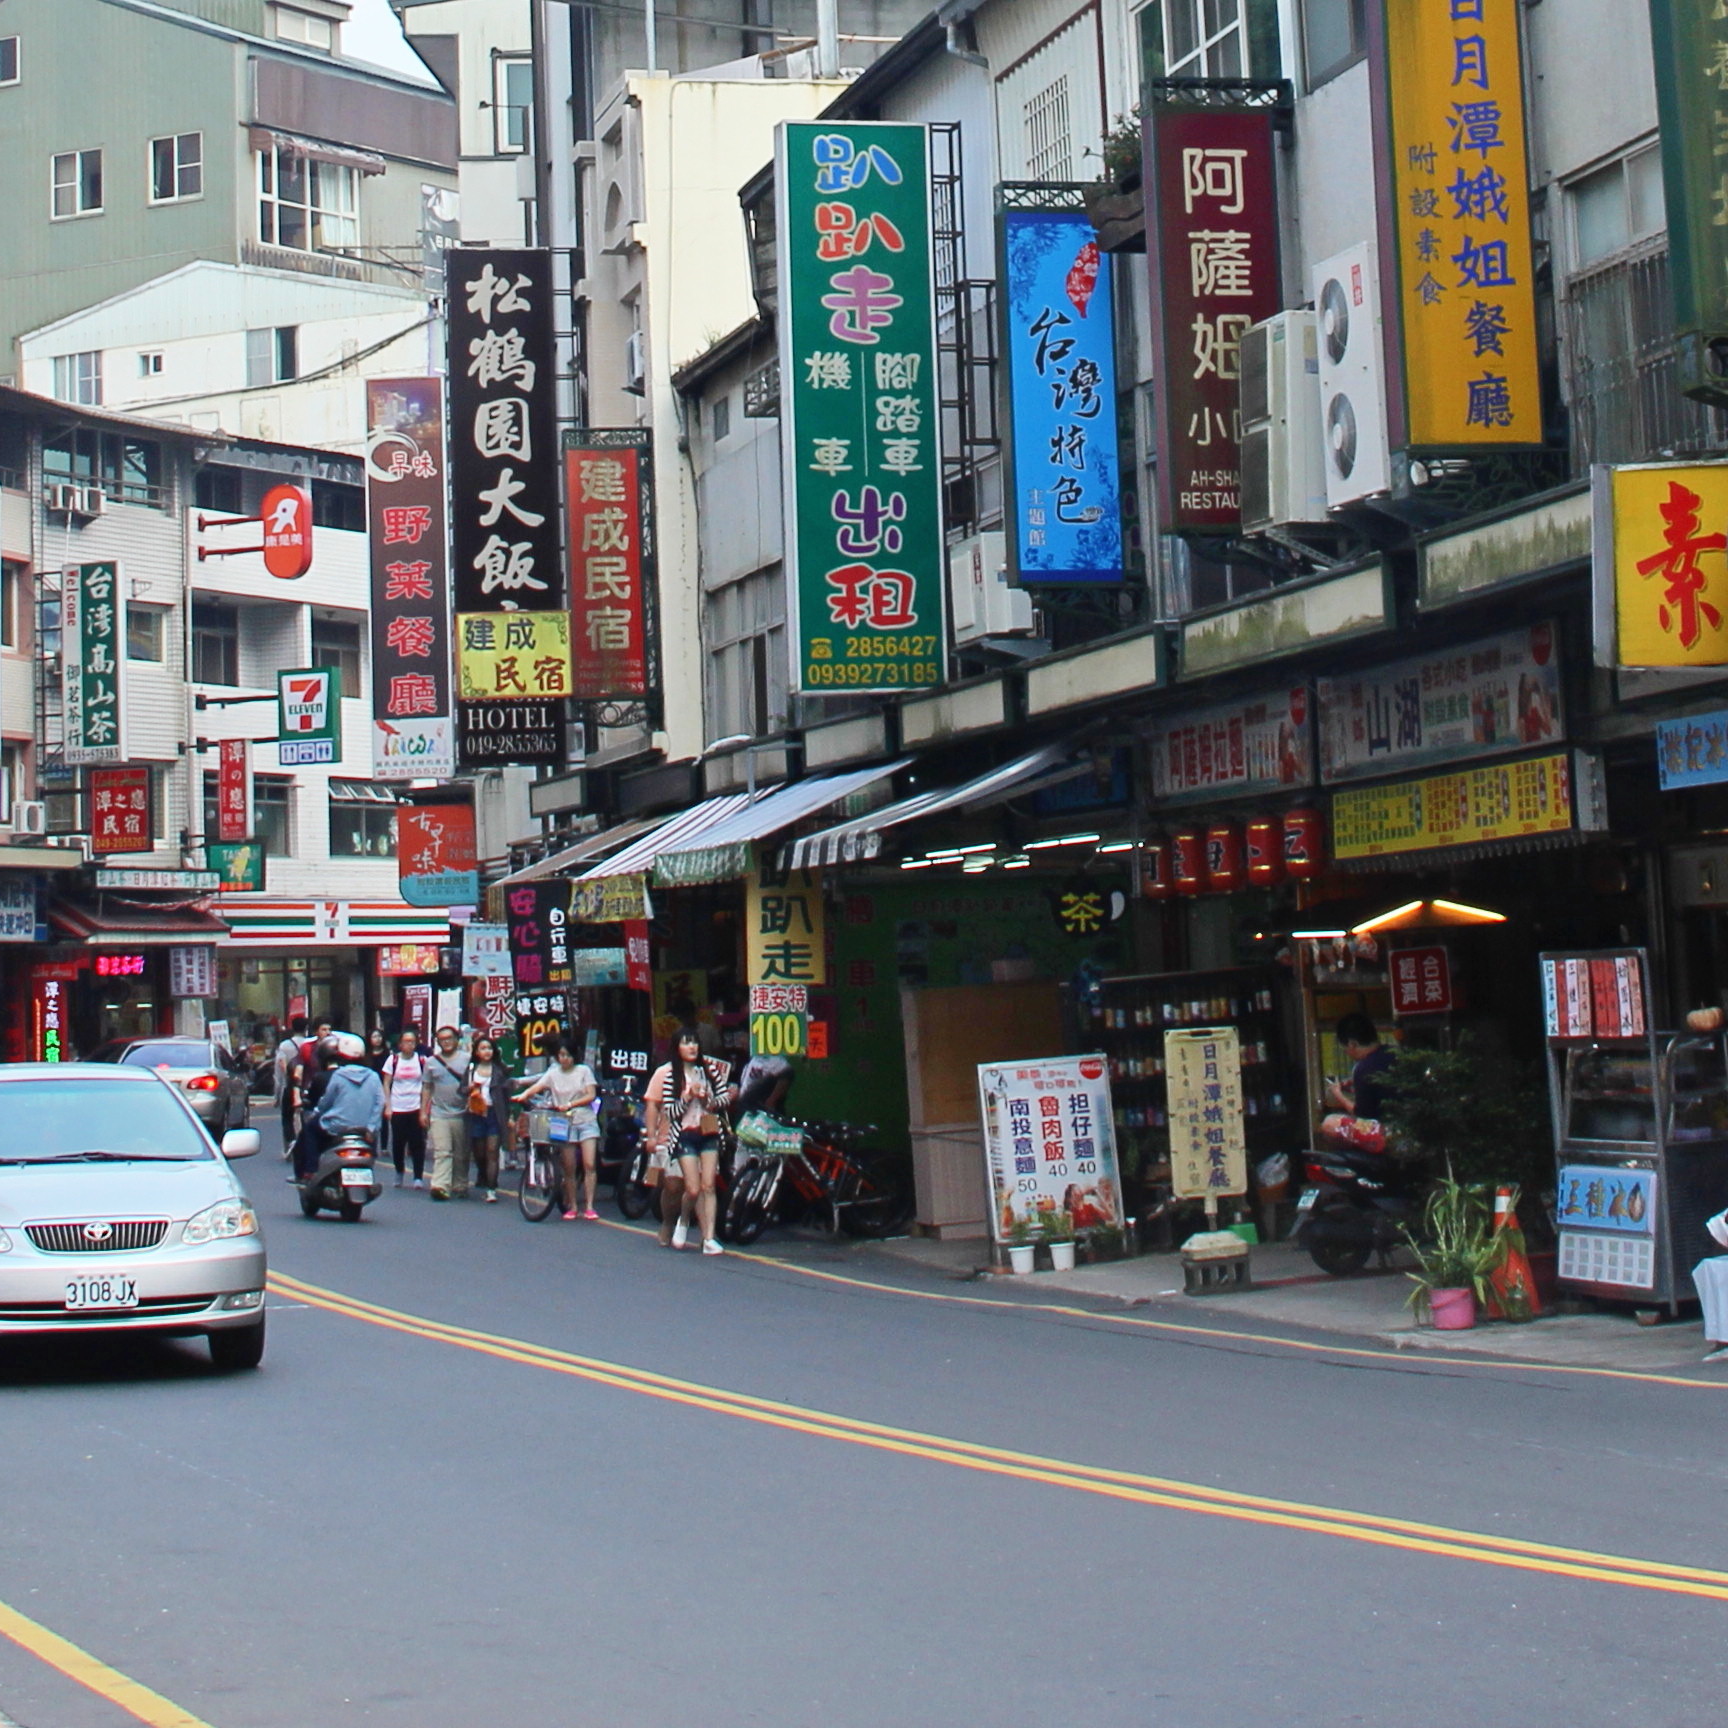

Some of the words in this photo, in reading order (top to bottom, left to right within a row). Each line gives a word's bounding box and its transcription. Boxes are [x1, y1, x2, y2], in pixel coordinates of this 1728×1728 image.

[813, 133, 906, 346] 趴趴走
[1408, 142, 1448, 307] 附設素食
[805, 350, 853, 478] 機車
[874, 351, 923, 478] 腳踏車
[466, 263, 549, 612] 松鶴園大飯
[1027, 487, 1048, 548] 主題館
[266, 532, 303, 547] 康是美
[579, 457, 632, 654] 建成民宿
[825, 484, 919, 630] 出租
[382, 505, 438, 716] 野菜餐廳
[464, 618, 536, 653] 建成
[845, 635, 938, 658] 2856427
[494, 656, 566, 694] 民宿
[808, 661, 939, 686] 0939273185
[466, 707, 555, 731] HOTEL
[466, 732, 557, 757] 049-2855365
[103, 813, 140, 836] 民宿
[1060, 892, 1105, 933] 茶
[549, 907, 568, 965] 自行車
[517, 994, 565, 1017] 捷安特
[751, 984, 807, 1013] 捷安特
[752, 1014, 800, 1056] 100
[610, 1048, 649, 1072] 出租
[1009, 1098, 1037, 1176] 南投意麵
[1038, 1095, 1066, 1162] 魯肉飯
[1069, 1093, 1096, 1160] 担仔麵
[1017, 1177, 1038, 1193] 50
[1048, 1162, 1069, 1177] 40
[1077, 1160, 1097, 1175] 40
